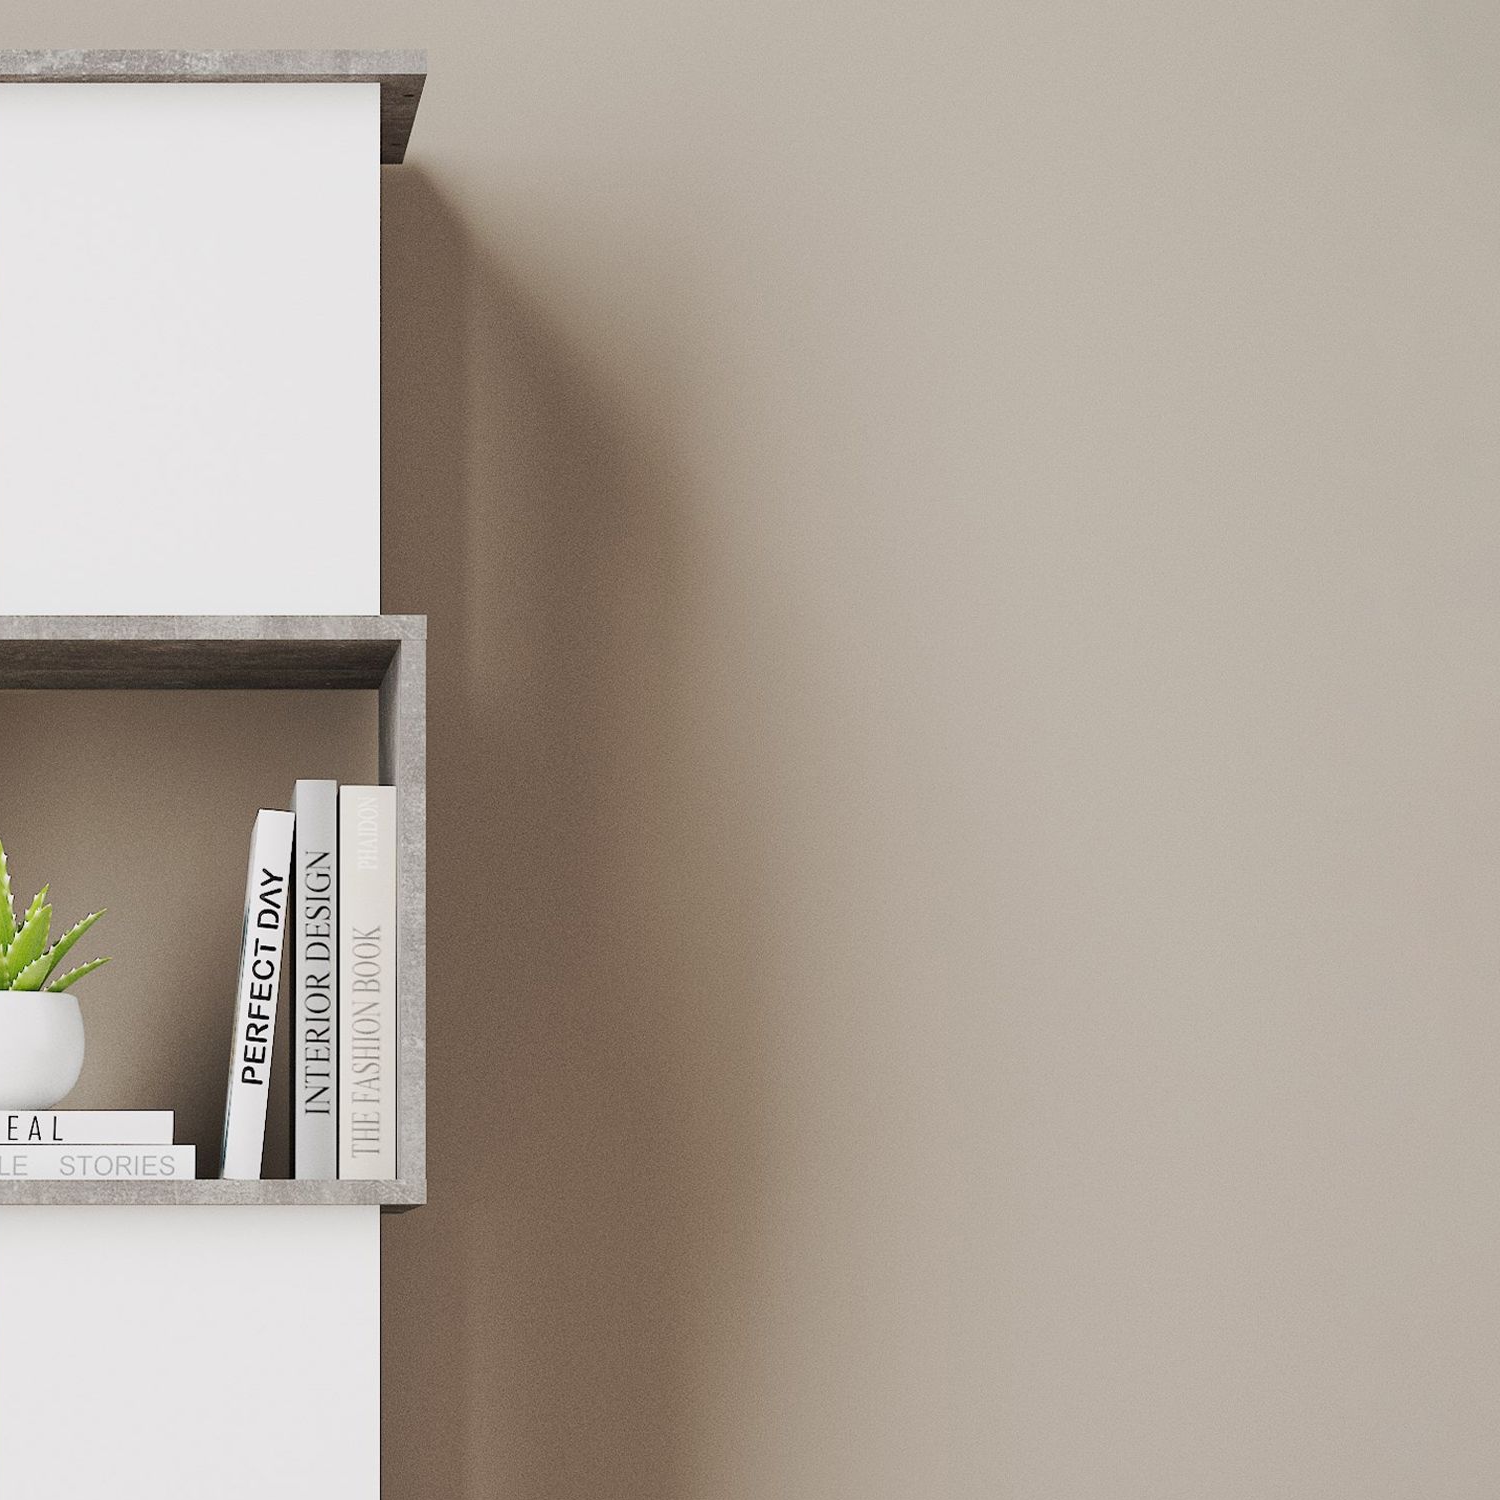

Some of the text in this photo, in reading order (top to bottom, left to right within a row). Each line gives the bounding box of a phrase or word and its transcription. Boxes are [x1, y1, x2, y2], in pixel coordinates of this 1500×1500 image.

[357, 796, 379, 871] PHAIDON
[241, 868, 284, 1085] PERFECT DAY
[304, 850, 332, 1116] INTERIOR DESIGN
[351, 926, 381, 1158] THE FASHION BOOK
[59, 1154, 176, 1176] STORIES
